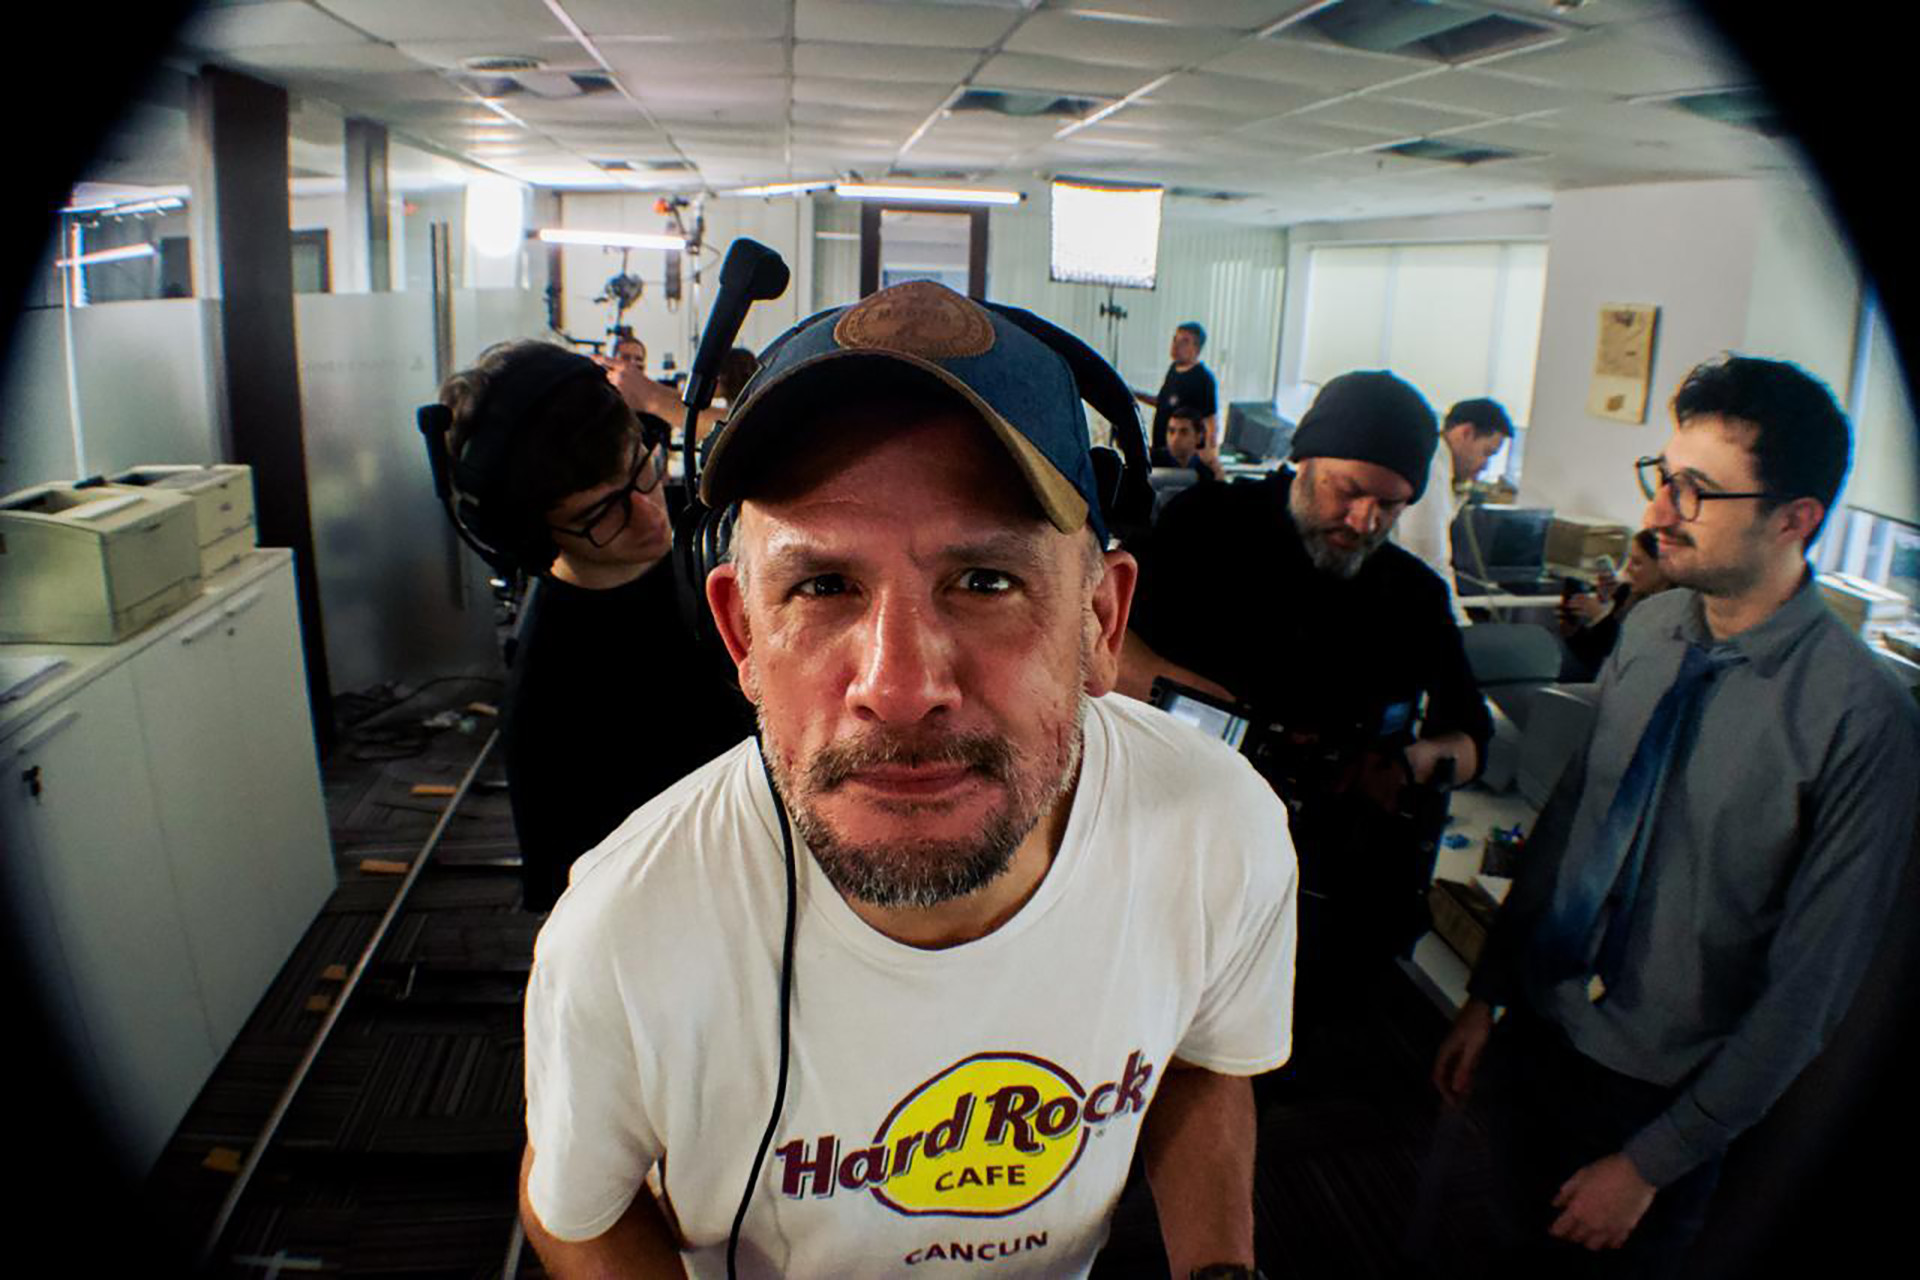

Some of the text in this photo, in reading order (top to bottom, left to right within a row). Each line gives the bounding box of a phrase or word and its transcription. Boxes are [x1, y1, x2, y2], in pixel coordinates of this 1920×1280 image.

[775, 1049, 1153, 1199] Hard Rock
[934, 1164, 1026, 1192] CAFE
[904, 1231, 1048, 1265] CANCUN
